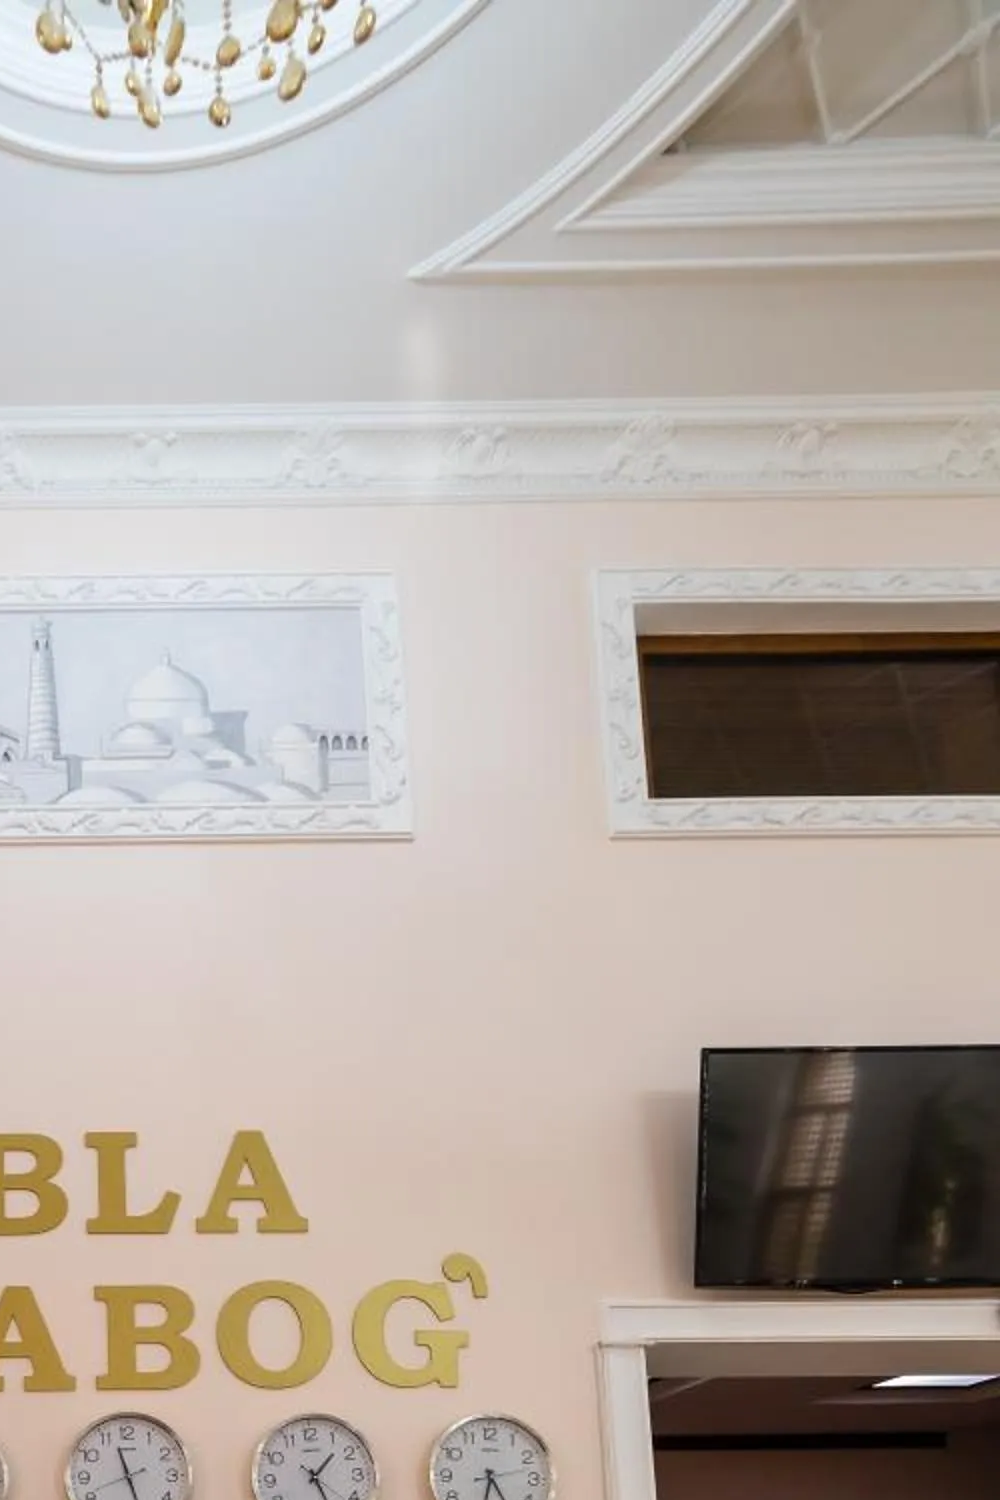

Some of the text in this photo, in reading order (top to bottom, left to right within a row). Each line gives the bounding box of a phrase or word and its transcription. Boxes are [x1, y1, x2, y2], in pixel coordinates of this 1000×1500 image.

[99, 1431, 111, 1447] 11
[146, 1430, 152, 1445] 1
[282, 1434, 296, 1449] 11
[303, 1427, 318, 1441] 12
[329, 1431, 335, 1445] 1
[461, 1429, 475, 1445] 11
[483, 1427, 498, 1442] 12
[509, 1433, 516, 1447] 1
[77, 1448, 100, 1463] 10
[159, 1446, 171, 1461] 2
[261, 1450, 285, 1466] 10
[343, 1445, 356, 1461] 2
[440, 1447, 463, 1461] 10
[521, 1449, 534, 1465] 2
[77, 1470, 91, 1486] 9
[165, 1467, 179, 1483] 3
[263, 1473, 277, 1489] 9
[351, 1467, 365, 1482] 3
[439, 1467, 453, 1483] 9
[527, 1471, 541, 1487] 3
